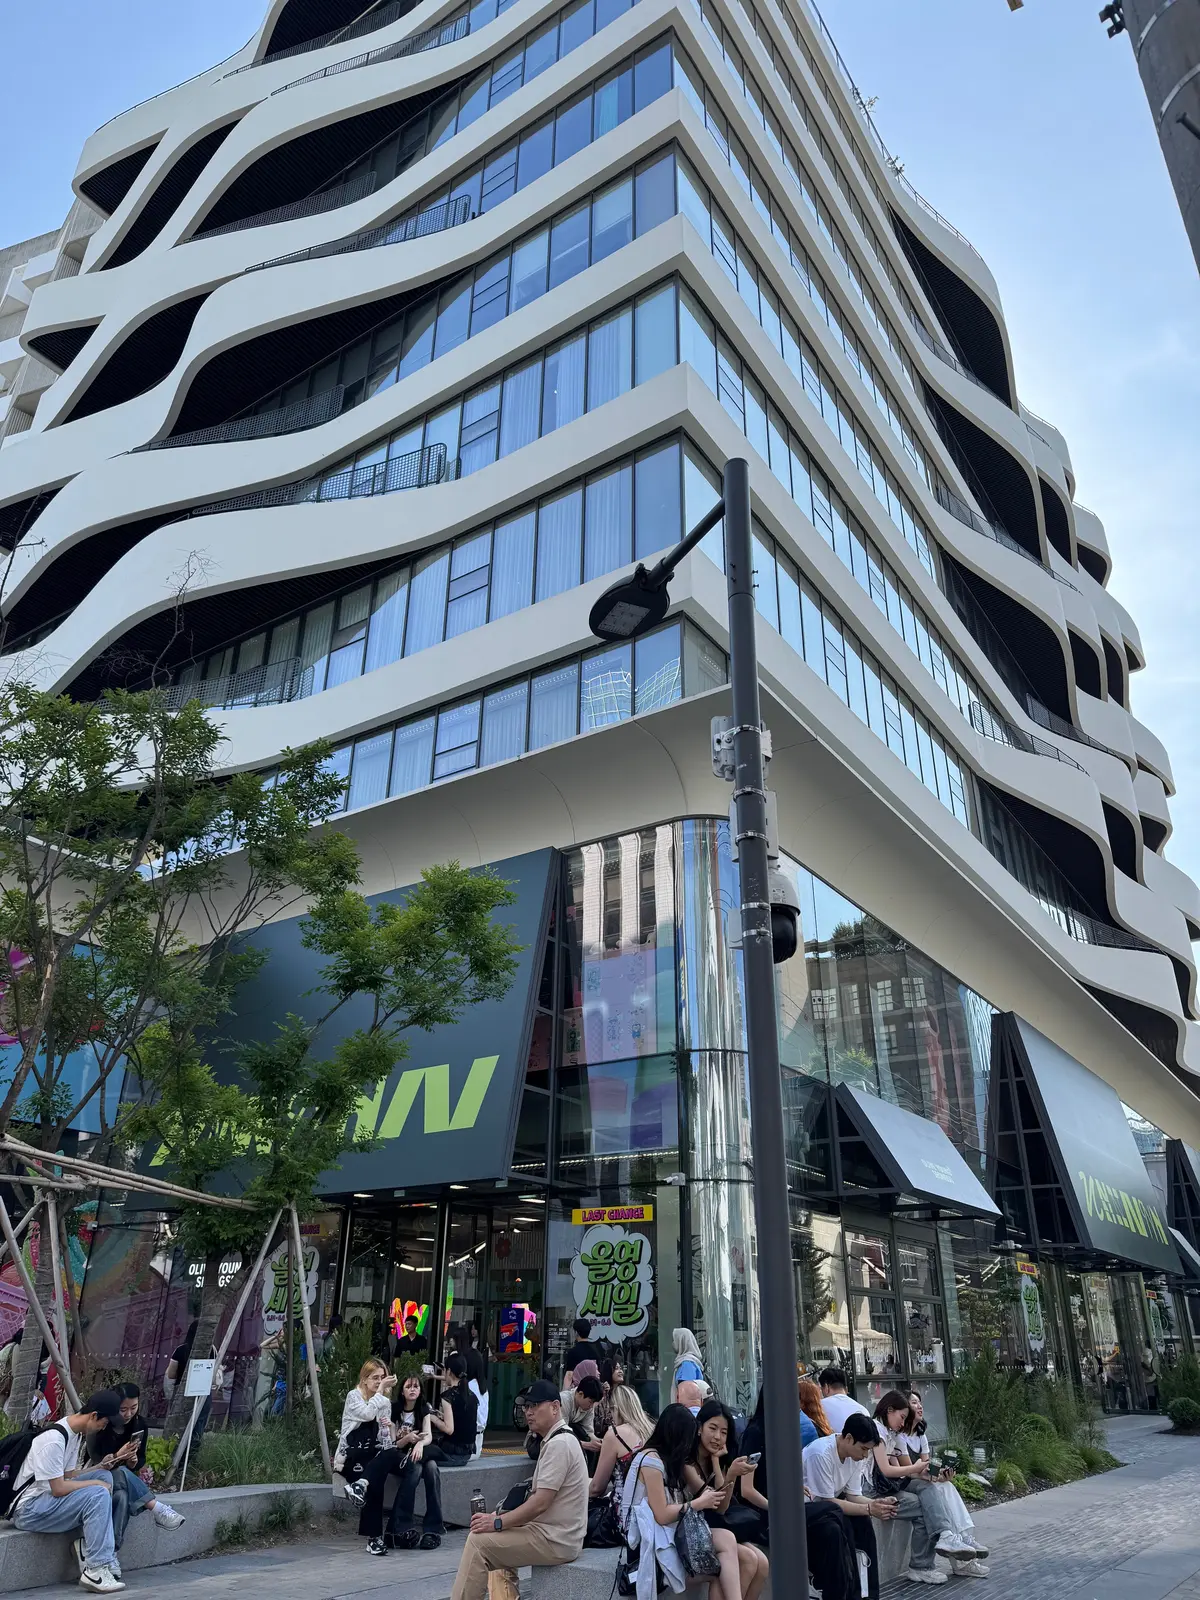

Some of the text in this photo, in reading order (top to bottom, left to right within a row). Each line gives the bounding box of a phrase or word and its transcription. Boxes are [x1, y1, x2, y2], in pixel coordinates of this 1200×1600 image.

[582, 1207, 644, 1221] LAST CHANCE
[188, 1263, 207, 1276] OLI
[581, 1239, 644, 1285] 올영
[580, 1281, 645, 1326] 세일
